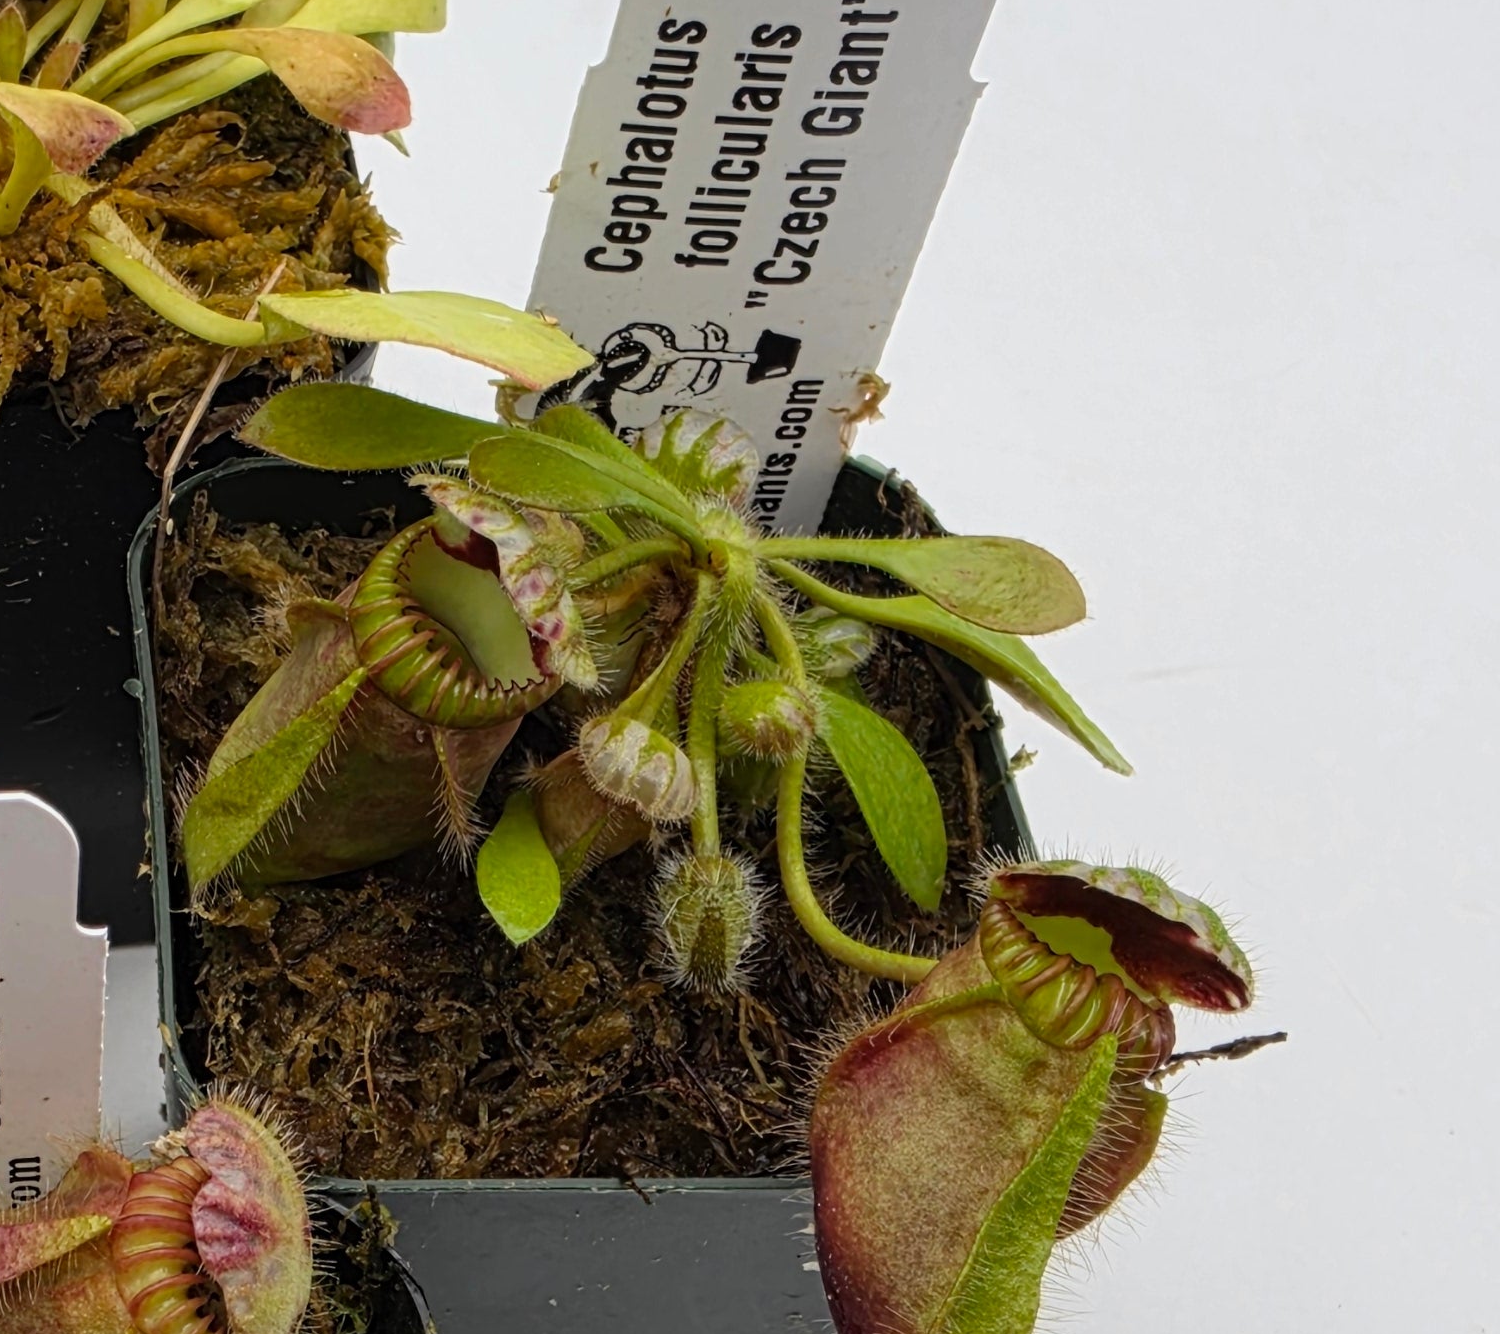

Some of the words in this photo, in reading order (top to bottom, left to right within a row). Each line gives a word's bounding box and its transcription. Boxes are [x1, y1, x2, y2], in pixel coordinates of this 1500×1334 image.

[585, 19, 707, 273] Cephalotus
[675, 22, 802, 267] follicularis
[744, 159, 847, 309] "Czech
